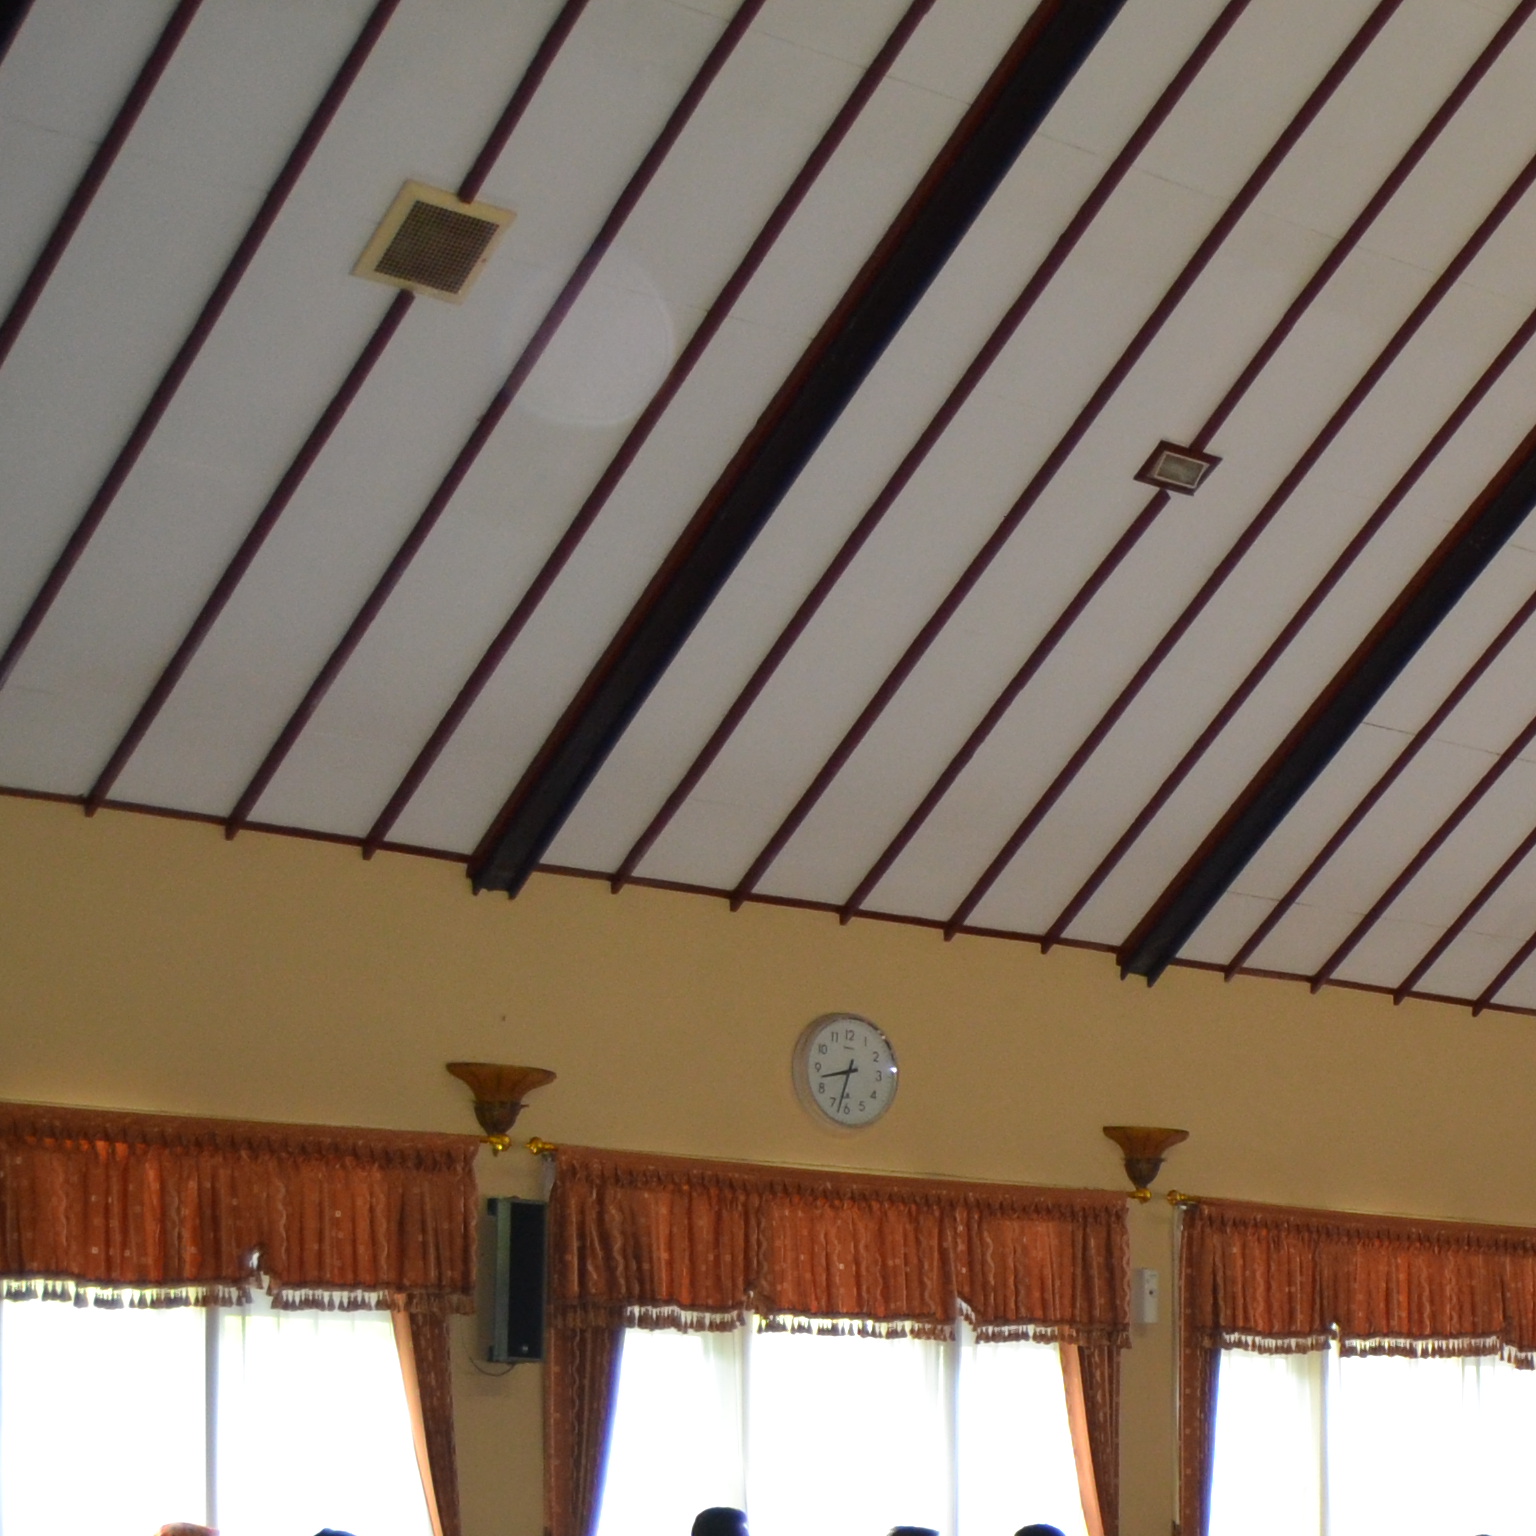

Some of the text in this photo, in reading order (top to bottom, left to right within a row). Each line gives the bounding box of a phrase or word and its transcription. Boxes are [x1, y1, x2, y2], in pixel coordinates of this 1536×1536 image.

[831, 1031, 839, 1043] 11
[845, 1029, 855, 1041] 12
[818, 1044, 828, 1055] 10
[872, 1051, 880, 1063] 2
[814, 1062, 822, 1073] 9
[875, 1070, 882, 1082] 3
[818, 1082, 826, 1094] 8
[870, 1090, 877, 1099] 4
[830, 1097, 836, 1107] 7
[858, 1101, 865, 1112] 5
[843, 1103, 850, 1115] 6
